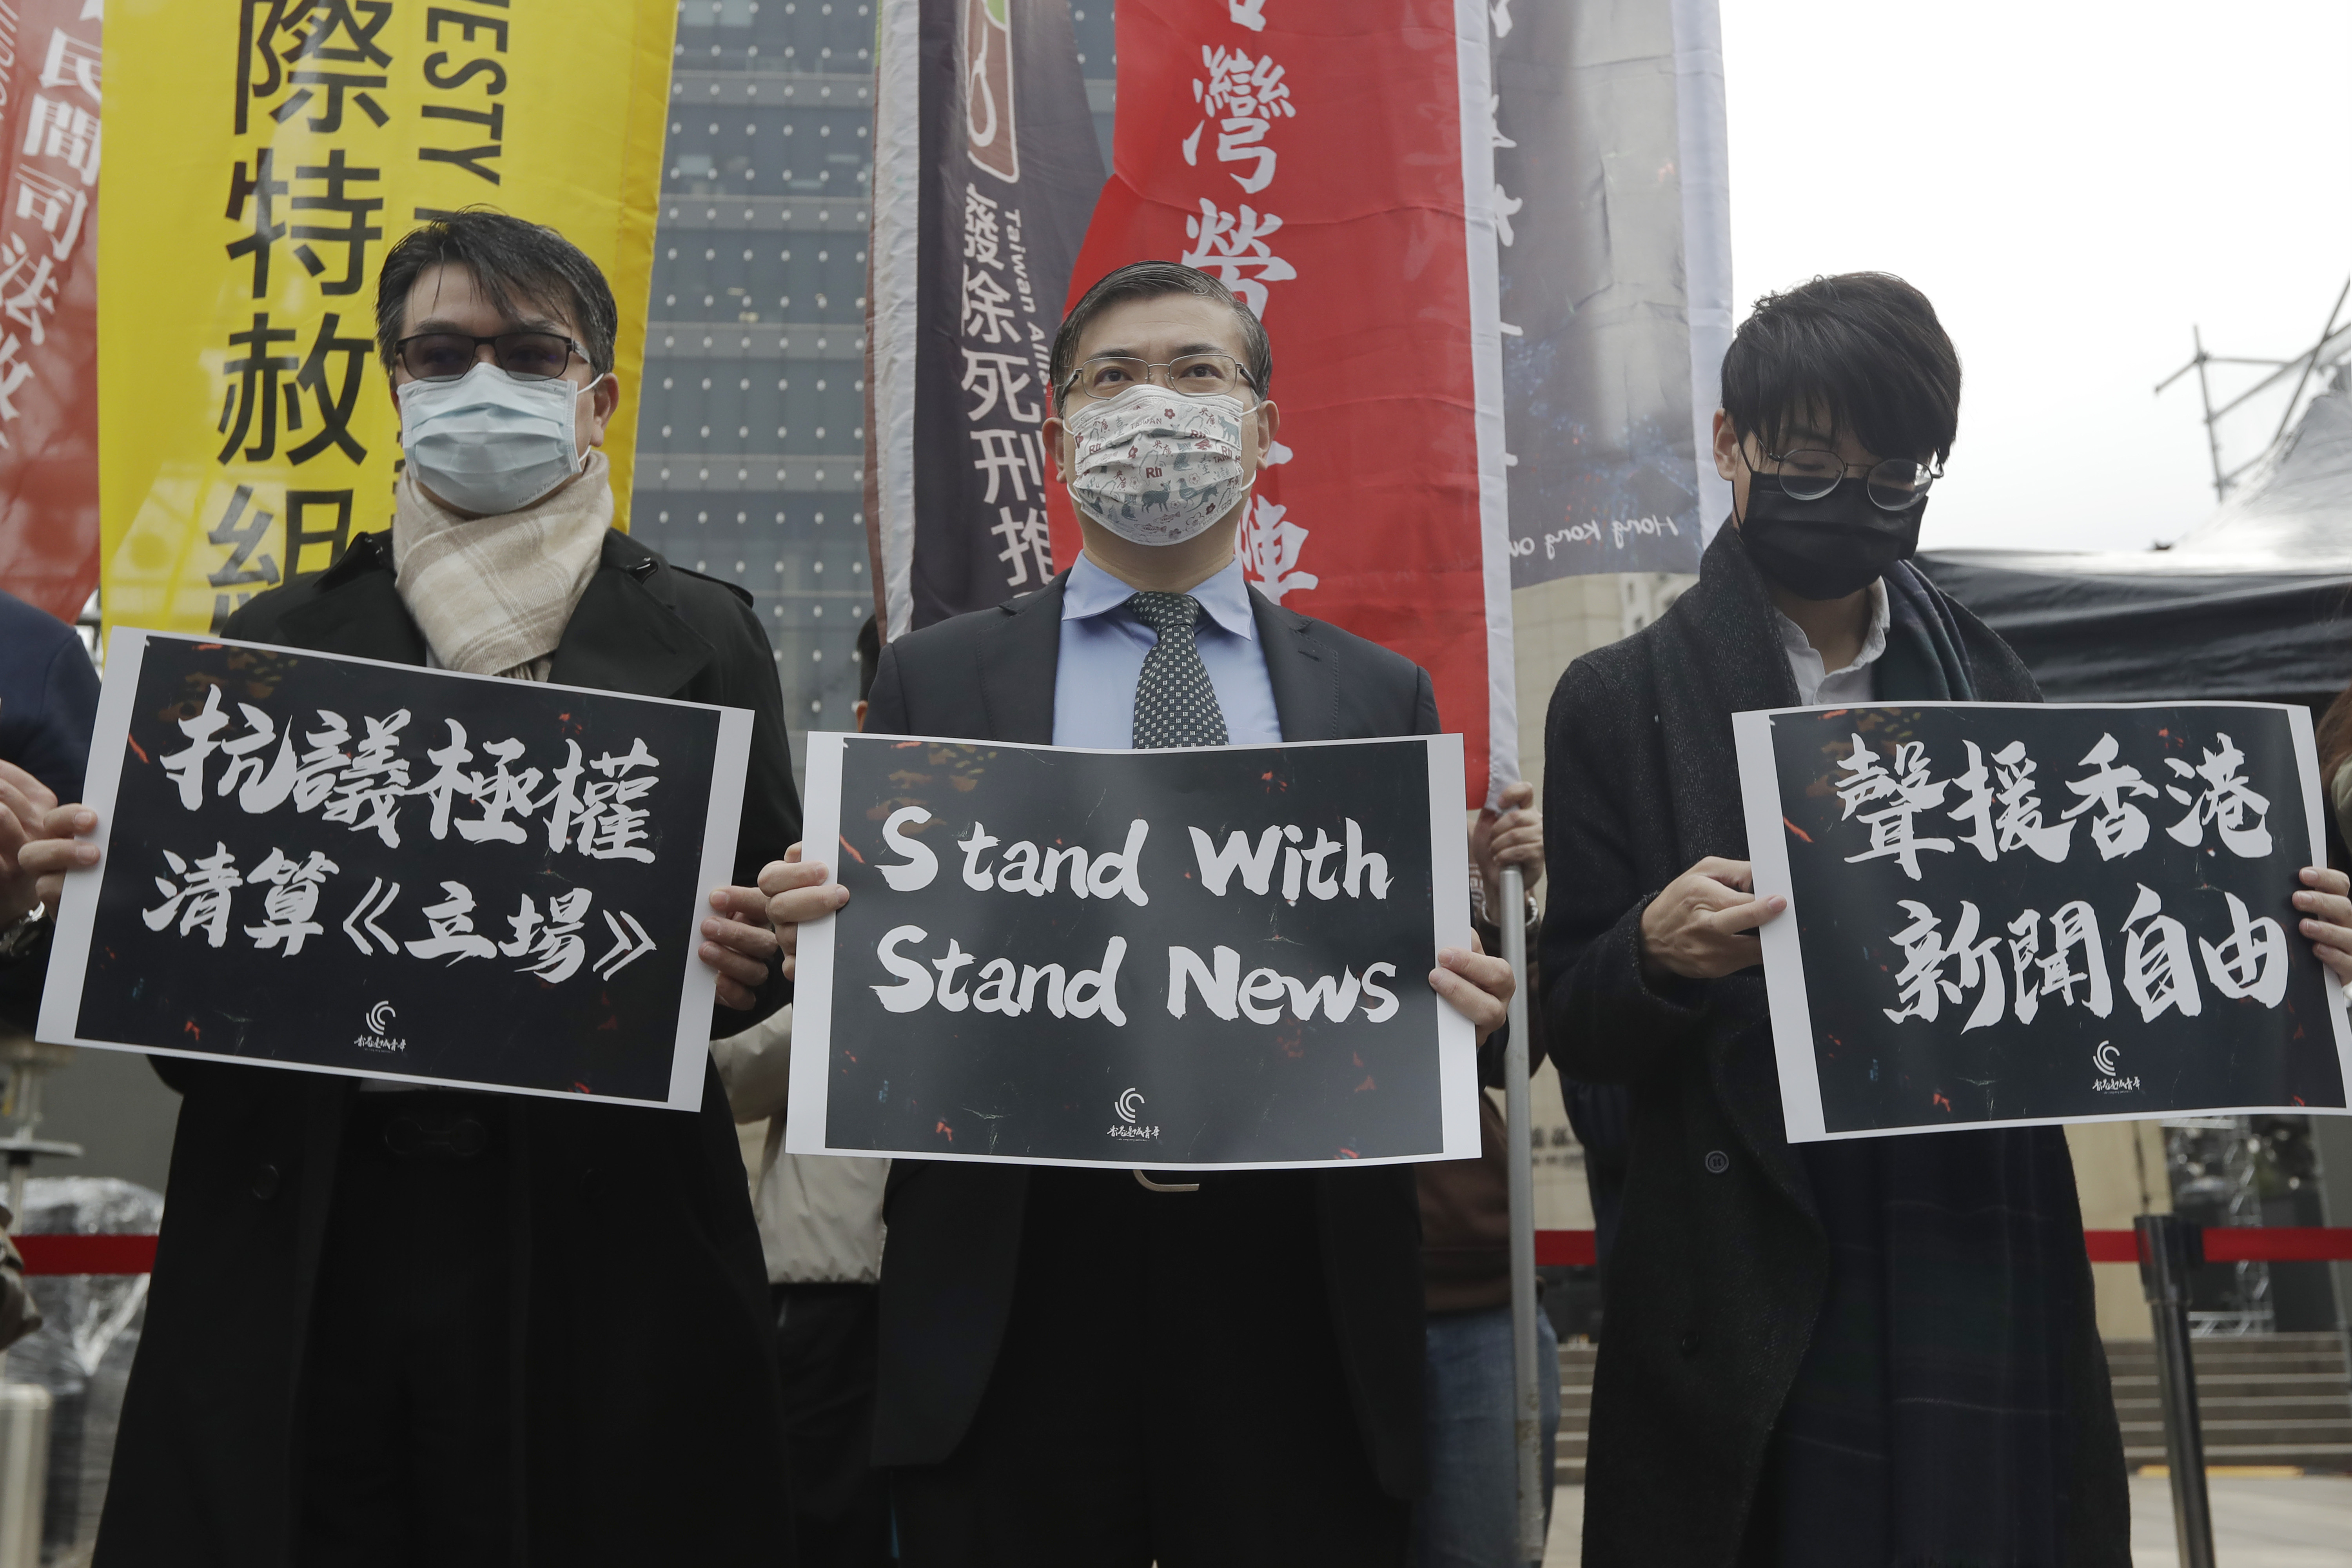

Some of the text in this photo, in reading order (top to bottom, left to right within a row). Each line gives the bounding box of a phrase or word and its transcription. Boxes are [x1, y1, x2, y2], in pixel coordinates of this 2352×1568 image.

[417, 0, 511, 187] ESTY
[1004, 209, 1036, 313] Taiwan
[160, 683, 659, 864] 抗議極權
[1835, 732, 2273, 881] 聲援香港
[874, 806, 1149, 907] Stand
[1188, 817, 1396, 901] With
[869, 924, 1400, 1027] Stand News
[1882, 882, 2289, 1035] 新聞自由
